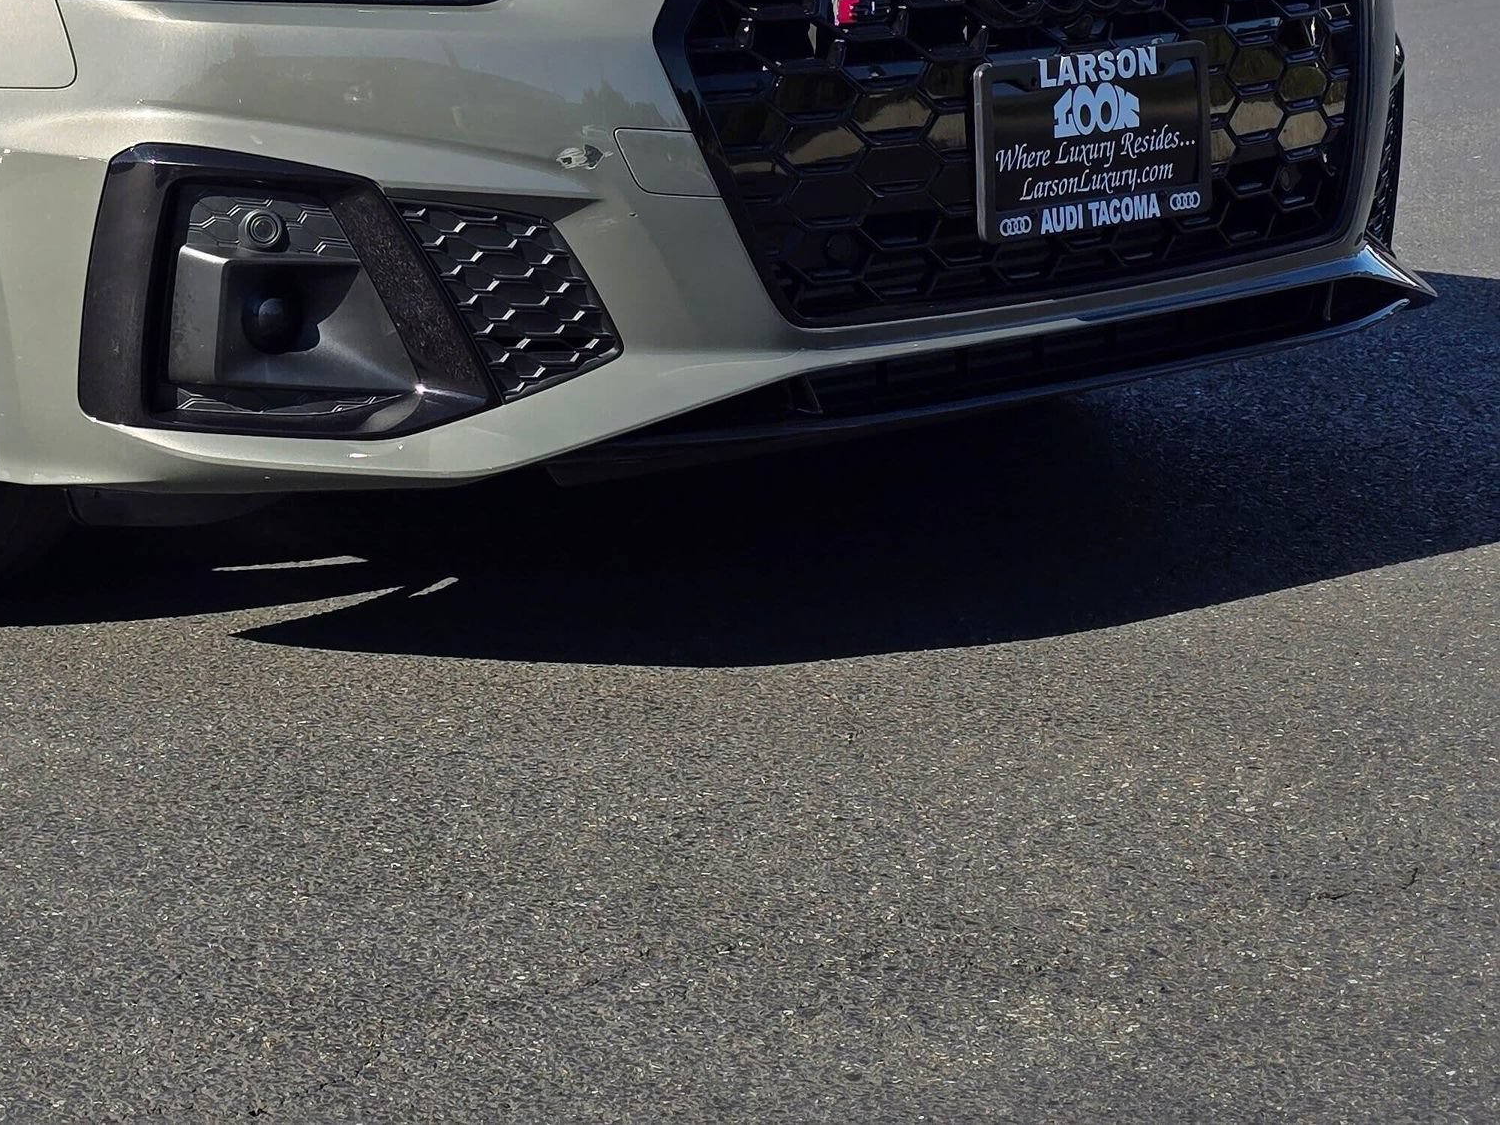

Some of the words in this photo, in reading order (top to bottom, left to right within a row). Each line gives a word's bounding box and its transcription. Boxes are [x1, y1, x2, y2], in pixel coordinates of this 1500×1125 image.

[1038, 45, 1158, 88] LARSON
[995, 143, 1051, 173] Where
[1055, 141, 1115, 168] Luxury
[1120, 123, 1196, 159] Resides...
[1019, 162, 1174, 201] LarsonLuxury.com
[1041, 203, 1084, 235] AUDI
[1088, 193, 1161, 227] TACOMA
